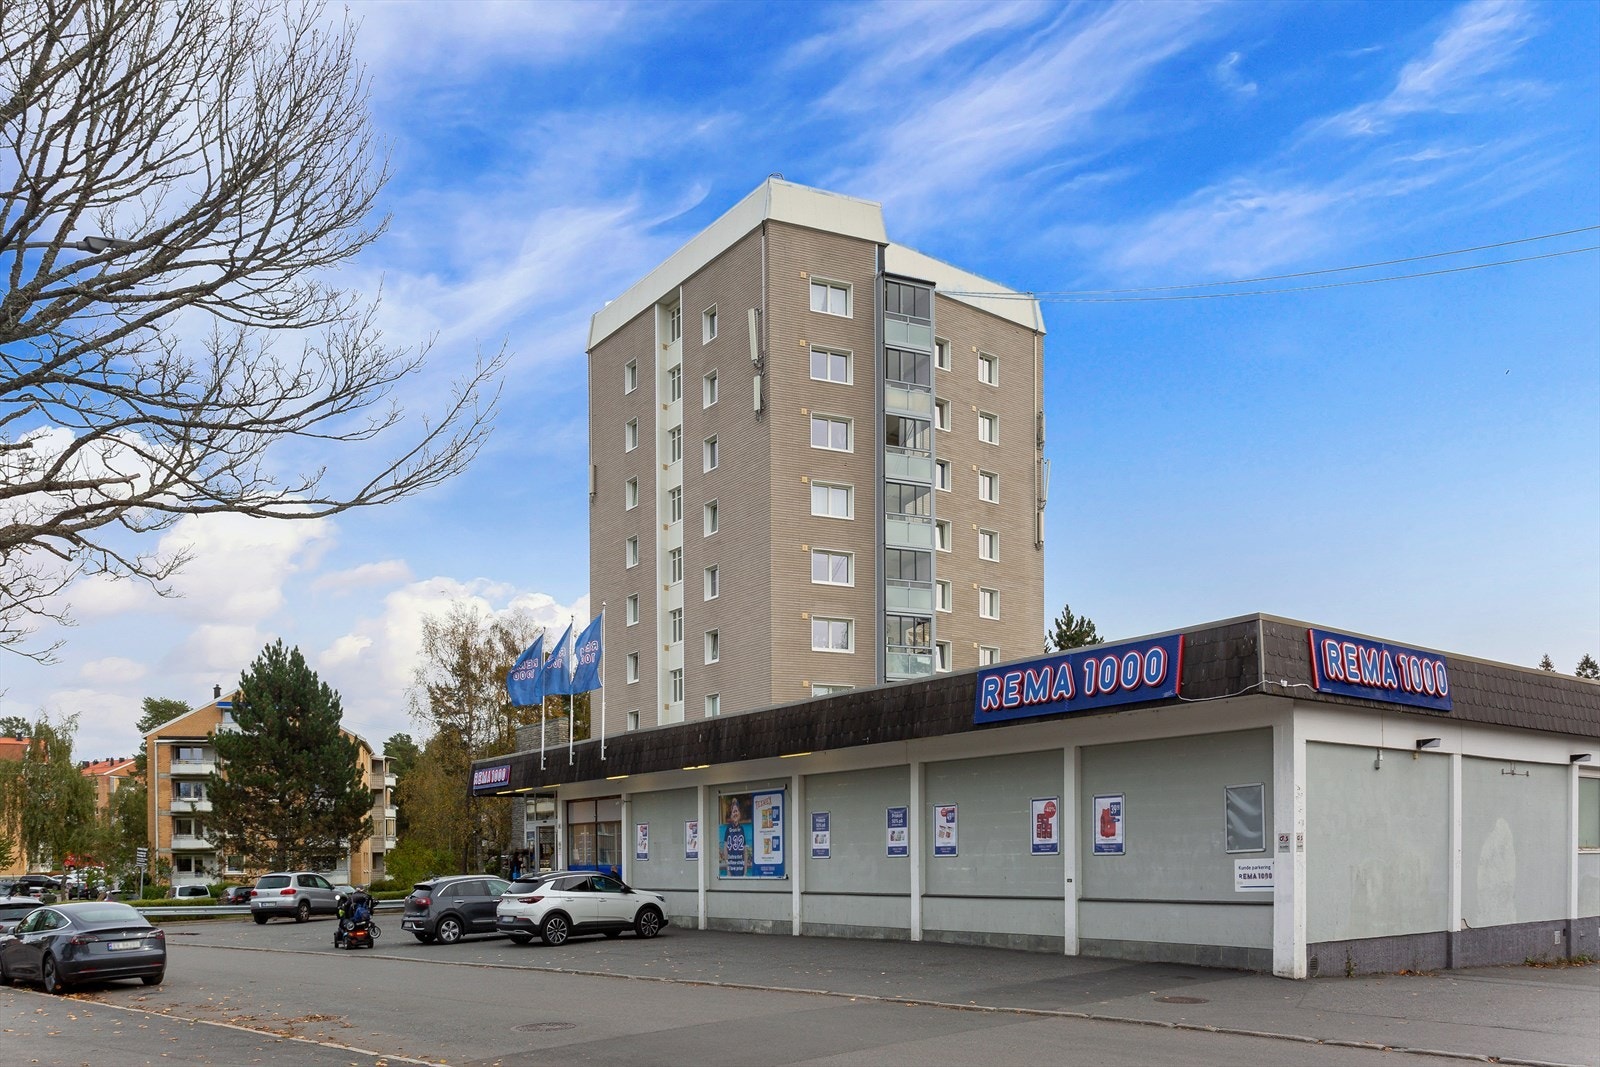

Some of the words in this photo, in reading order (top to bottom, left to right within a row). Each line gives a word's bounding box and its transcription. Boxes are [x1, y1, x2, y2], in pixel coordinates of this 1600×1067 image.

[981, 662, 1075, 711] REMA
[1084, 645, 1168, 697] 1000
[1321, 638, 1398, 690] REMA
[1395, 652, 1448, 697] 1000
[473, 770, 491, 785] REMA
[491, 767, 506, 783] 1000
[1258, 872, 1272, 880] 1000
